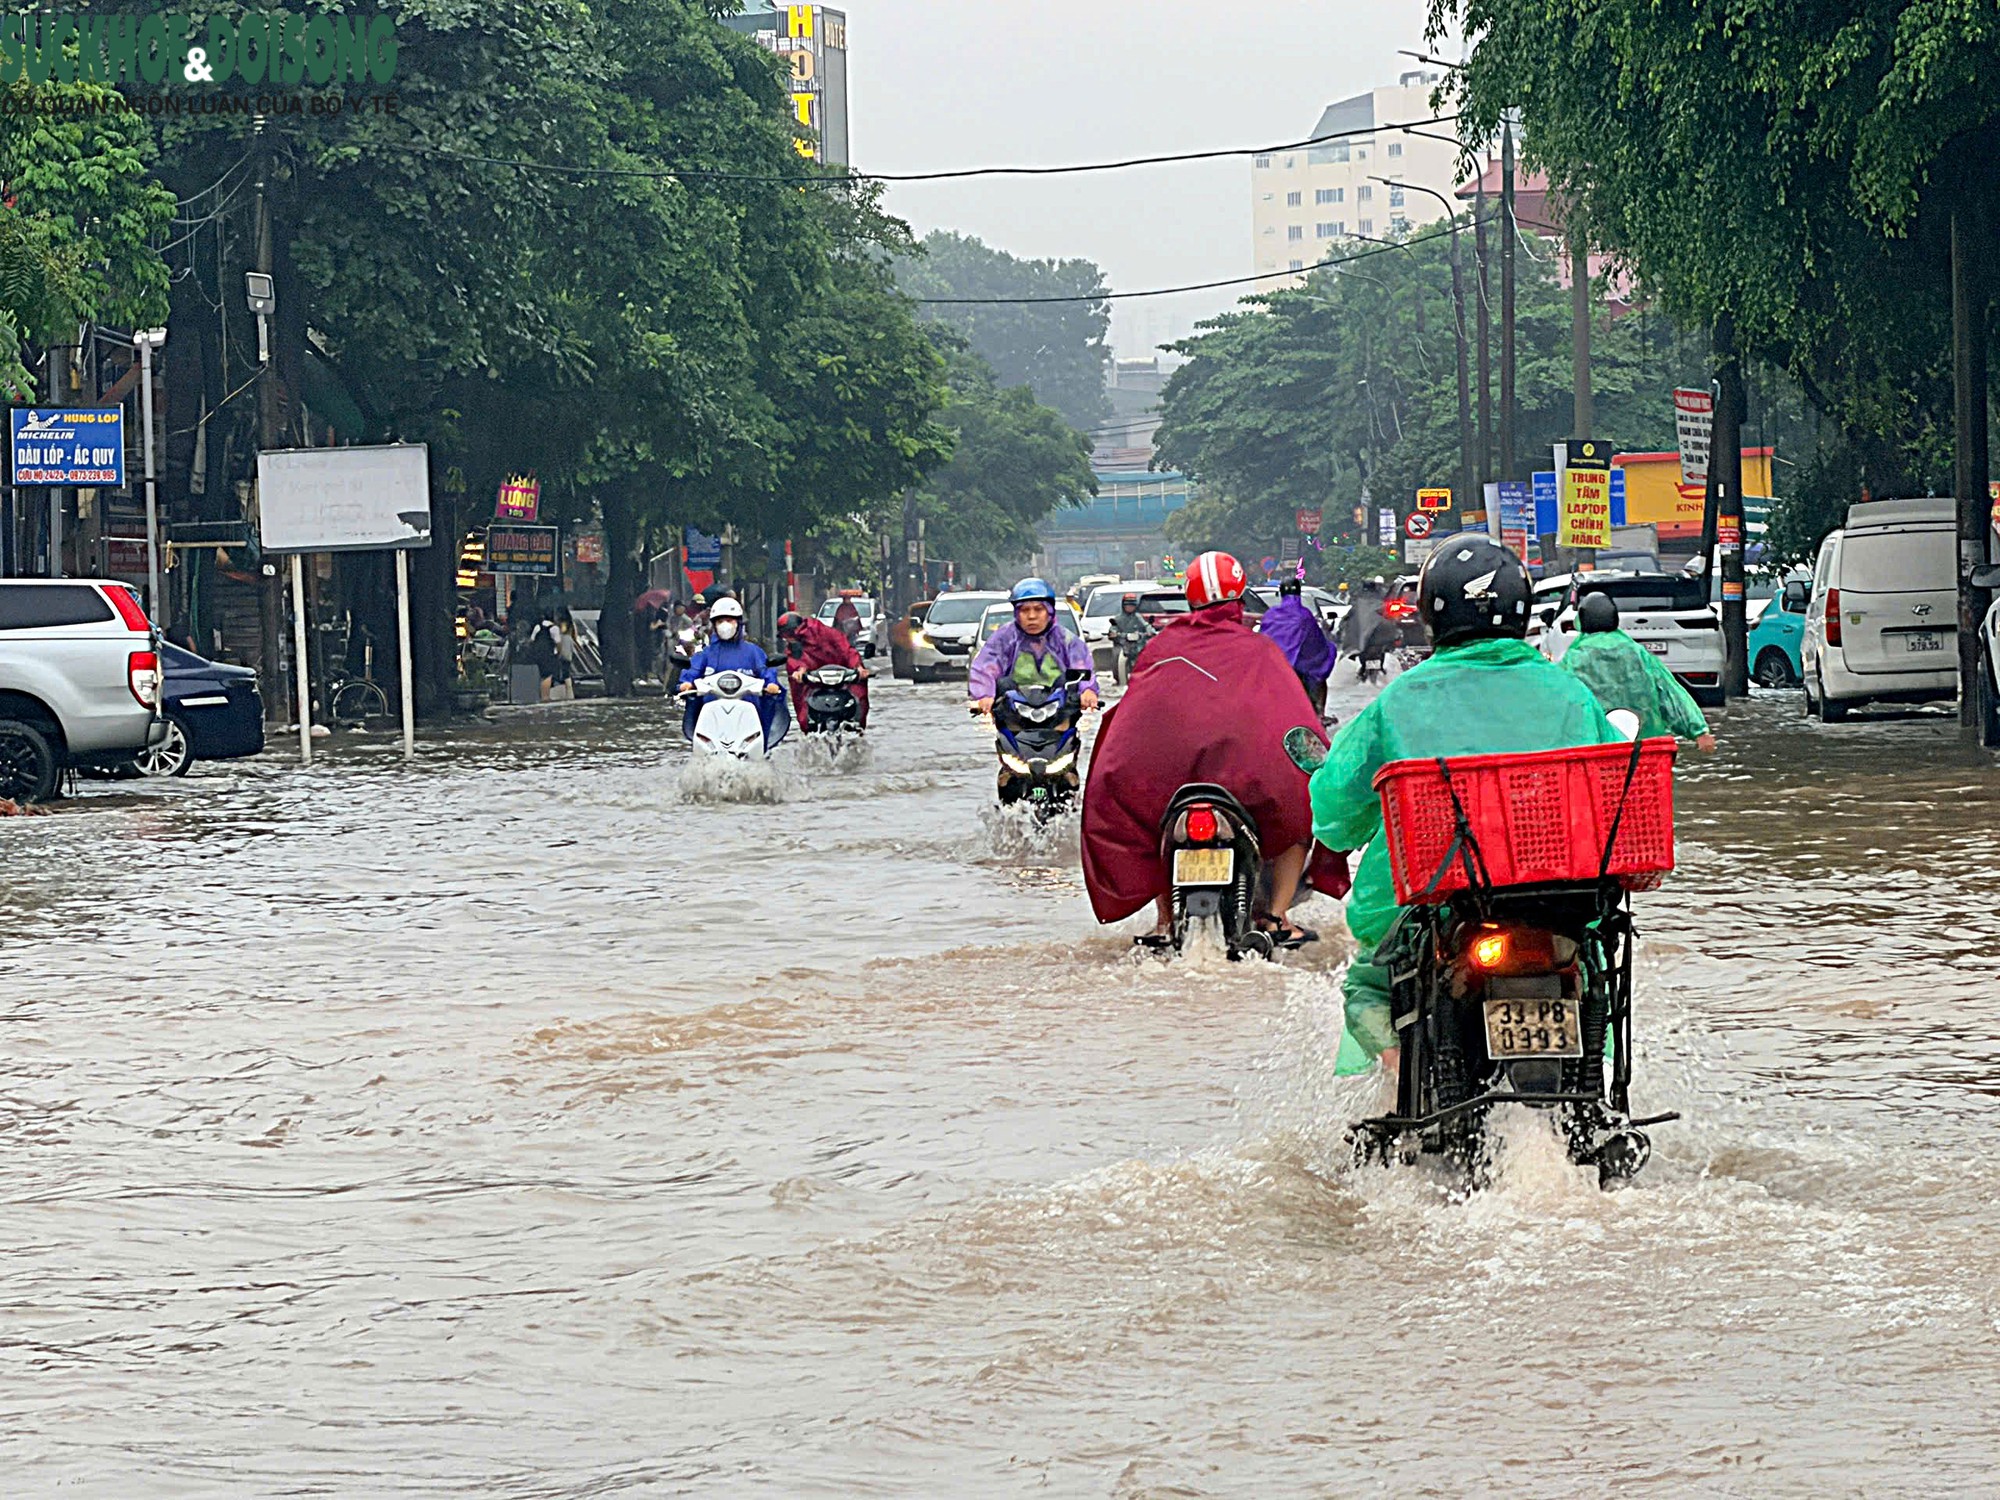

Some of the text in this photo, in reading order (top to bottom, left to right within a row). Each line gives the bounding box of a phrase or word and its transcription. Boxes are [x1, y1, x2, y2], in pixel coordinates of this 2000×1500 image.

[788, 5, 814, 158] HOTE
[17, 431, 75, 440] MICHELIN
[93, 447, 115, 467] QUY
[1572, 473, 1605, 484] TRUNG
[1576, 486, 1600, 499] TÂM
[1567, 503, 1607, 515] LAPTOP
[1677, 503, 1704, 513] KINH
